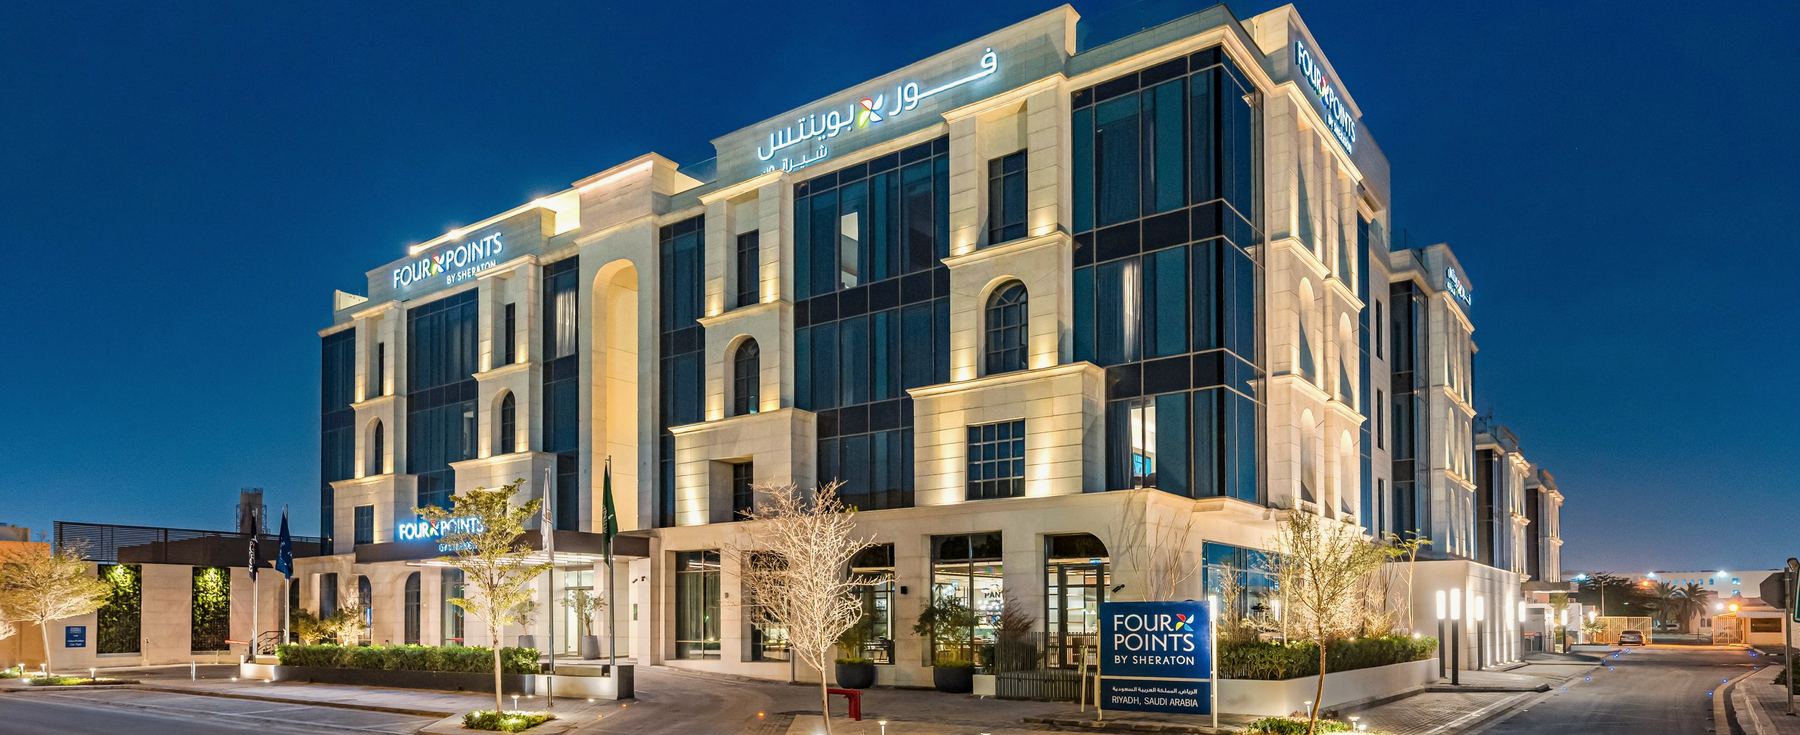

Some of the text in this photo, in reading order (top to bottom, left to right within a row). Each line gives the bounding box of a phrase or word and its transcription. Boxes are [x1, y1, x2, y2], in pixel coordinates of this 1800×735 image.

[1296, 40, 1322, 95] FOUR
[1329, 87, 1356, 142] POINTS
[757, 47, 998, 161] فور بوينتس
[393, 232, 503, 289] FOUR POINTS
[446, 273, 456, 285] BY
[399, 517, 484, 540] FOUR POINTS
[1113, 613, 1174, 632] FOUR
[1114, 633, 1195, 652] POINTS
[1114, 655, 1195, 666] BY SHERATON
[1111, 695, 1198, 708] RIYADH, SAUDI ARABIA
